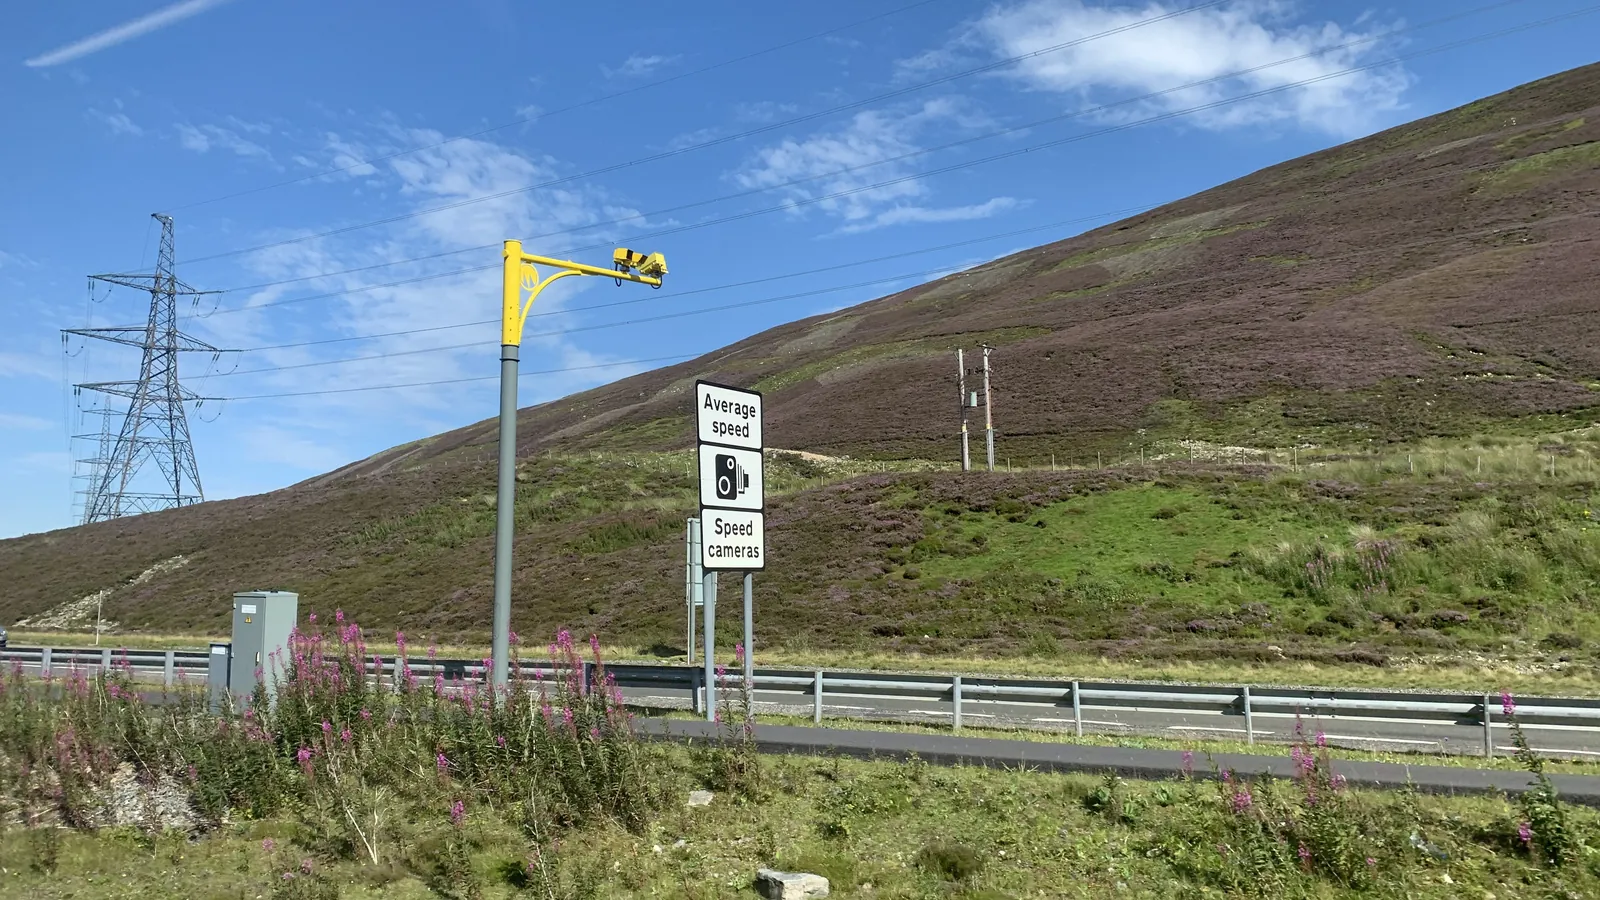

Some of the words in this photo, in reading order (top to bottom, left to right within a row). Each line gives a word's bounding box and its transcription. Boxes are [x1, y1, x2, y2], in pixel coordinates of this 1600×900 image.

[704, 393, 756, 420] Average
[712, 420, 749, 438] speed
[715, 517, 753, 538] Speed
[708, 544, 759, 558] cameras
